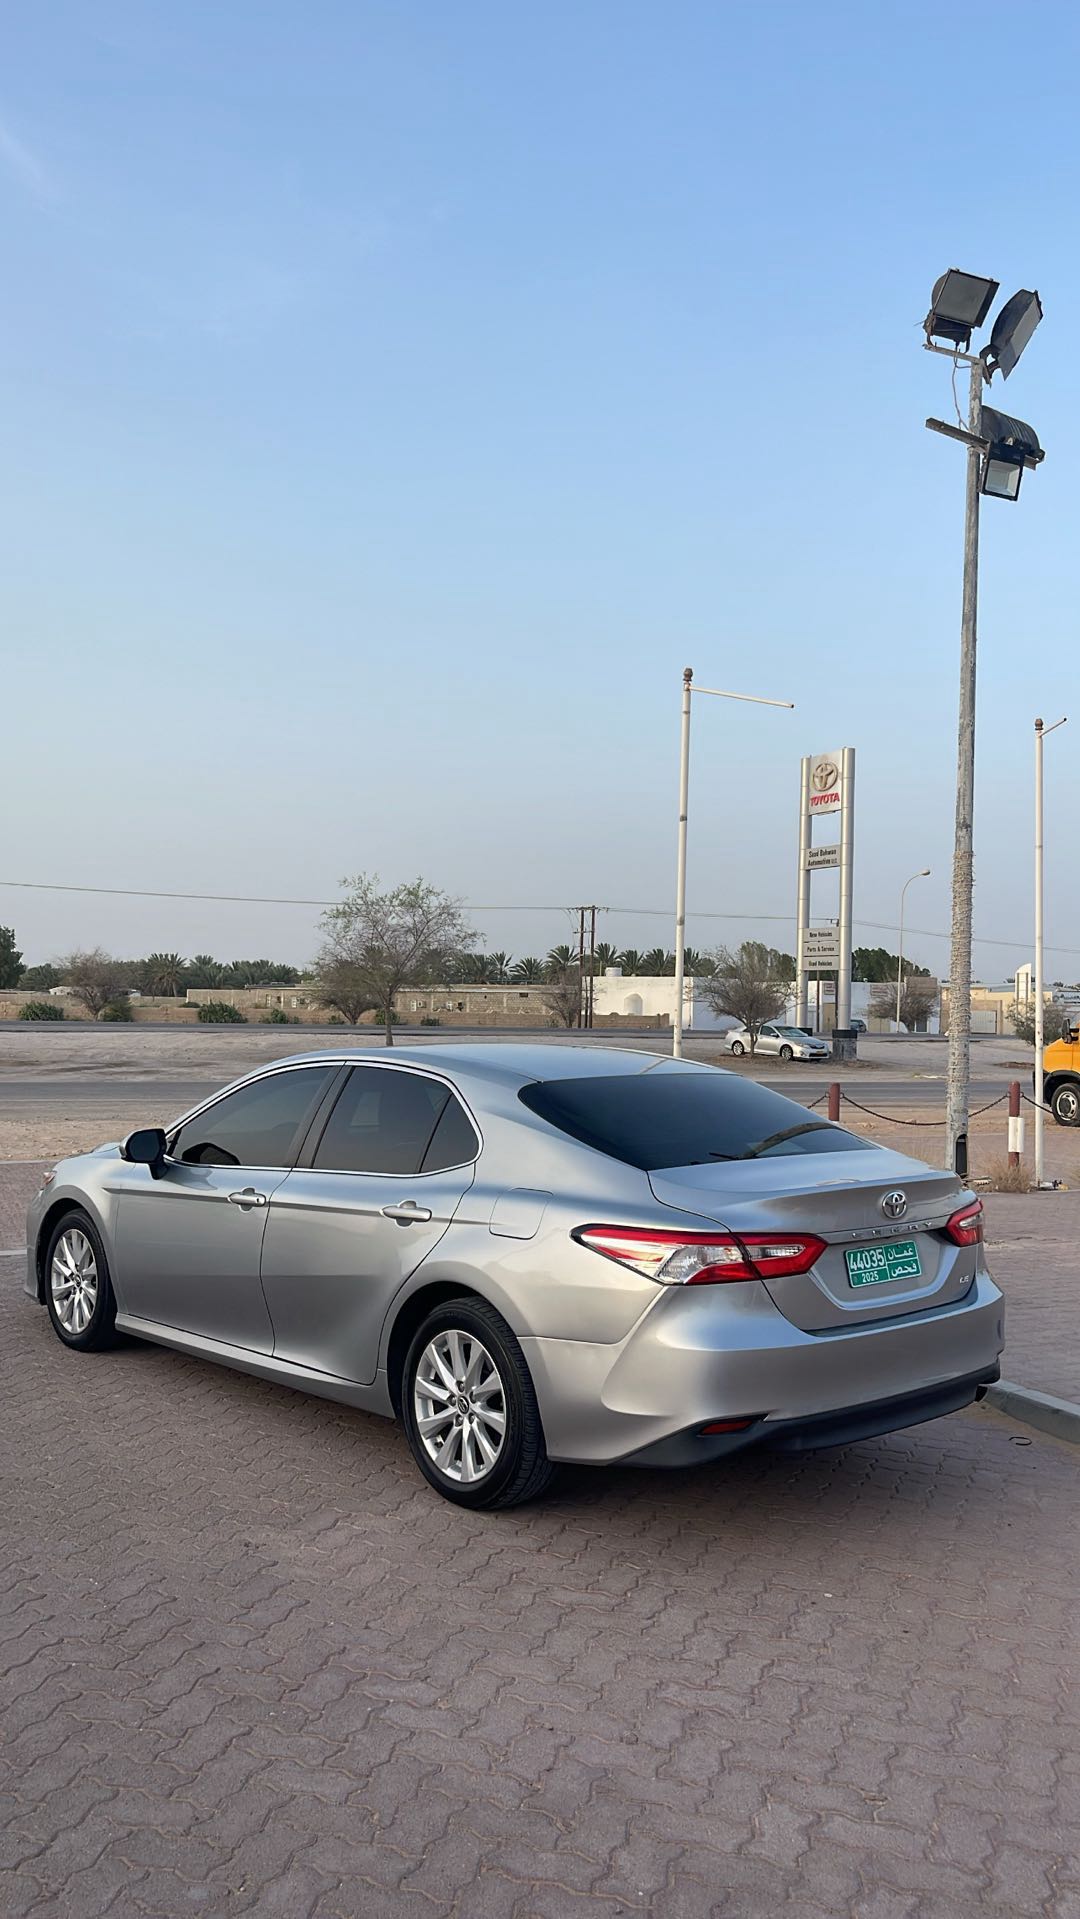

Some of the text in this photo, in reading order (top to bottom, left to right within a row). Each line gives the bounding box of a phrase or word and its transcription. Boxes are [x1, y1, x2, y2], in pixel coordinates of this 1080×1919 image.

[810, 792, 840, 806] TOYOTA
[852, 1222, 931, 1237] MRY
[850, 1249, 885, 1271] 44035
[891, 1261, 917, 1277] فحص
[861, 1271, 879, 1283] 2025
